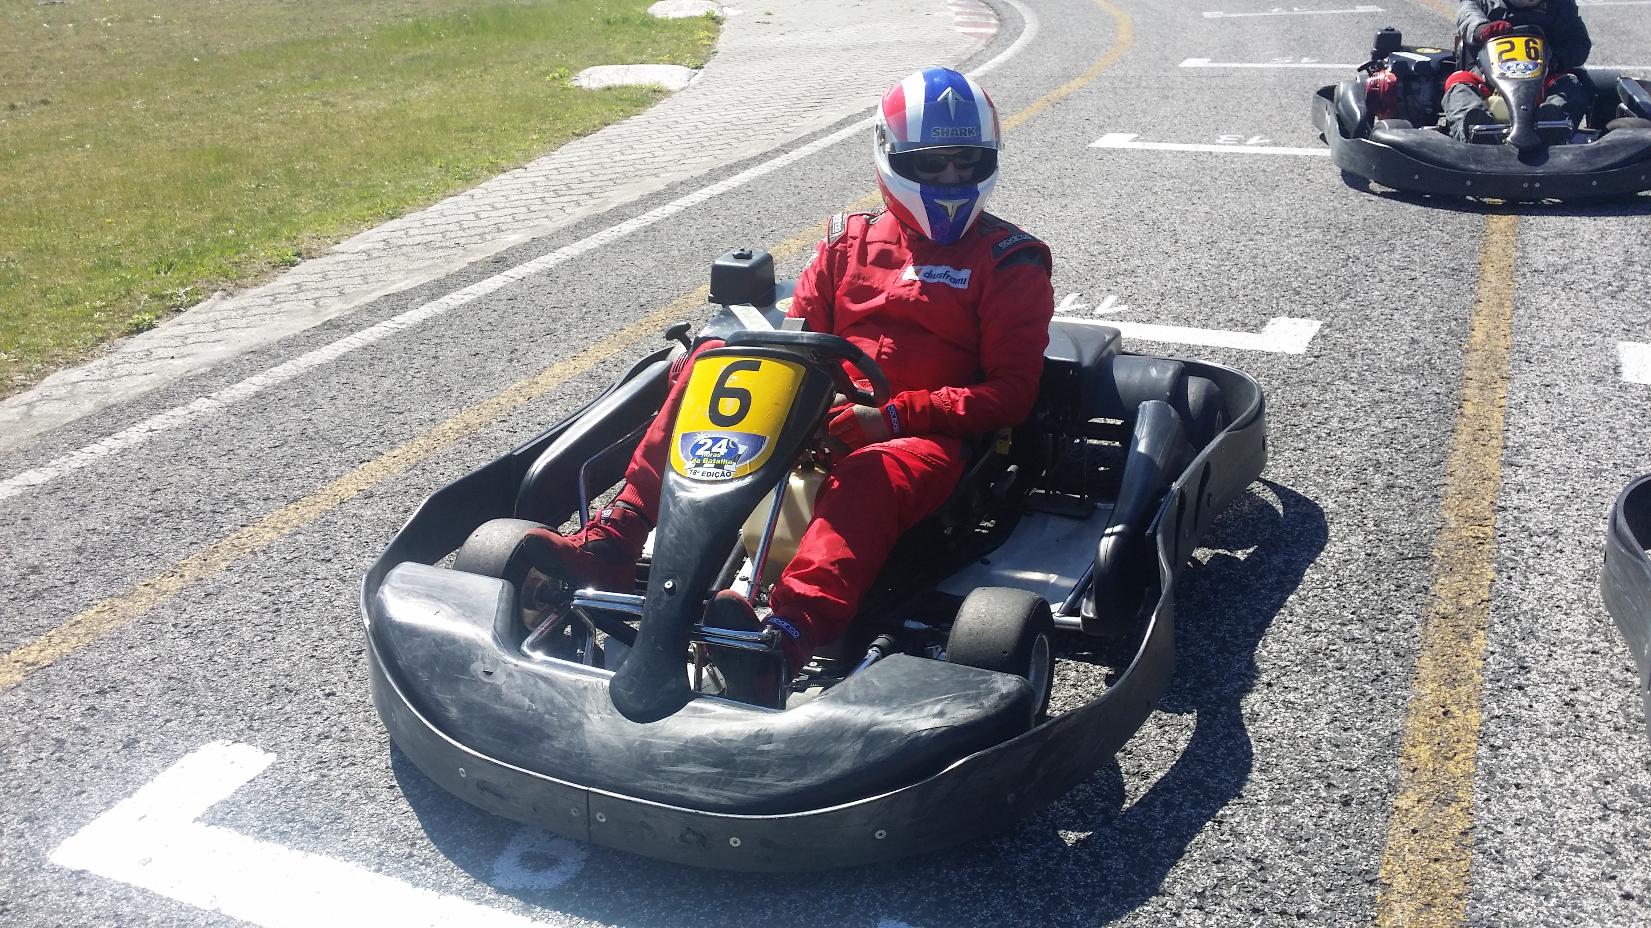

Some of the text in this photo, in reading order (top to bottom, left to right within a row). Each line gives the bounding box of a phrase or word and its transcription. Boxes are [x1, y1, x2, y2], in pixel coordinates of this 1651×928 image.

[1496, 38, 1540, 63] 26
[932, 126, 977, 138] SHARK
[708, 359, 763, 428] 6
[694, 438, 729, 456] 24
